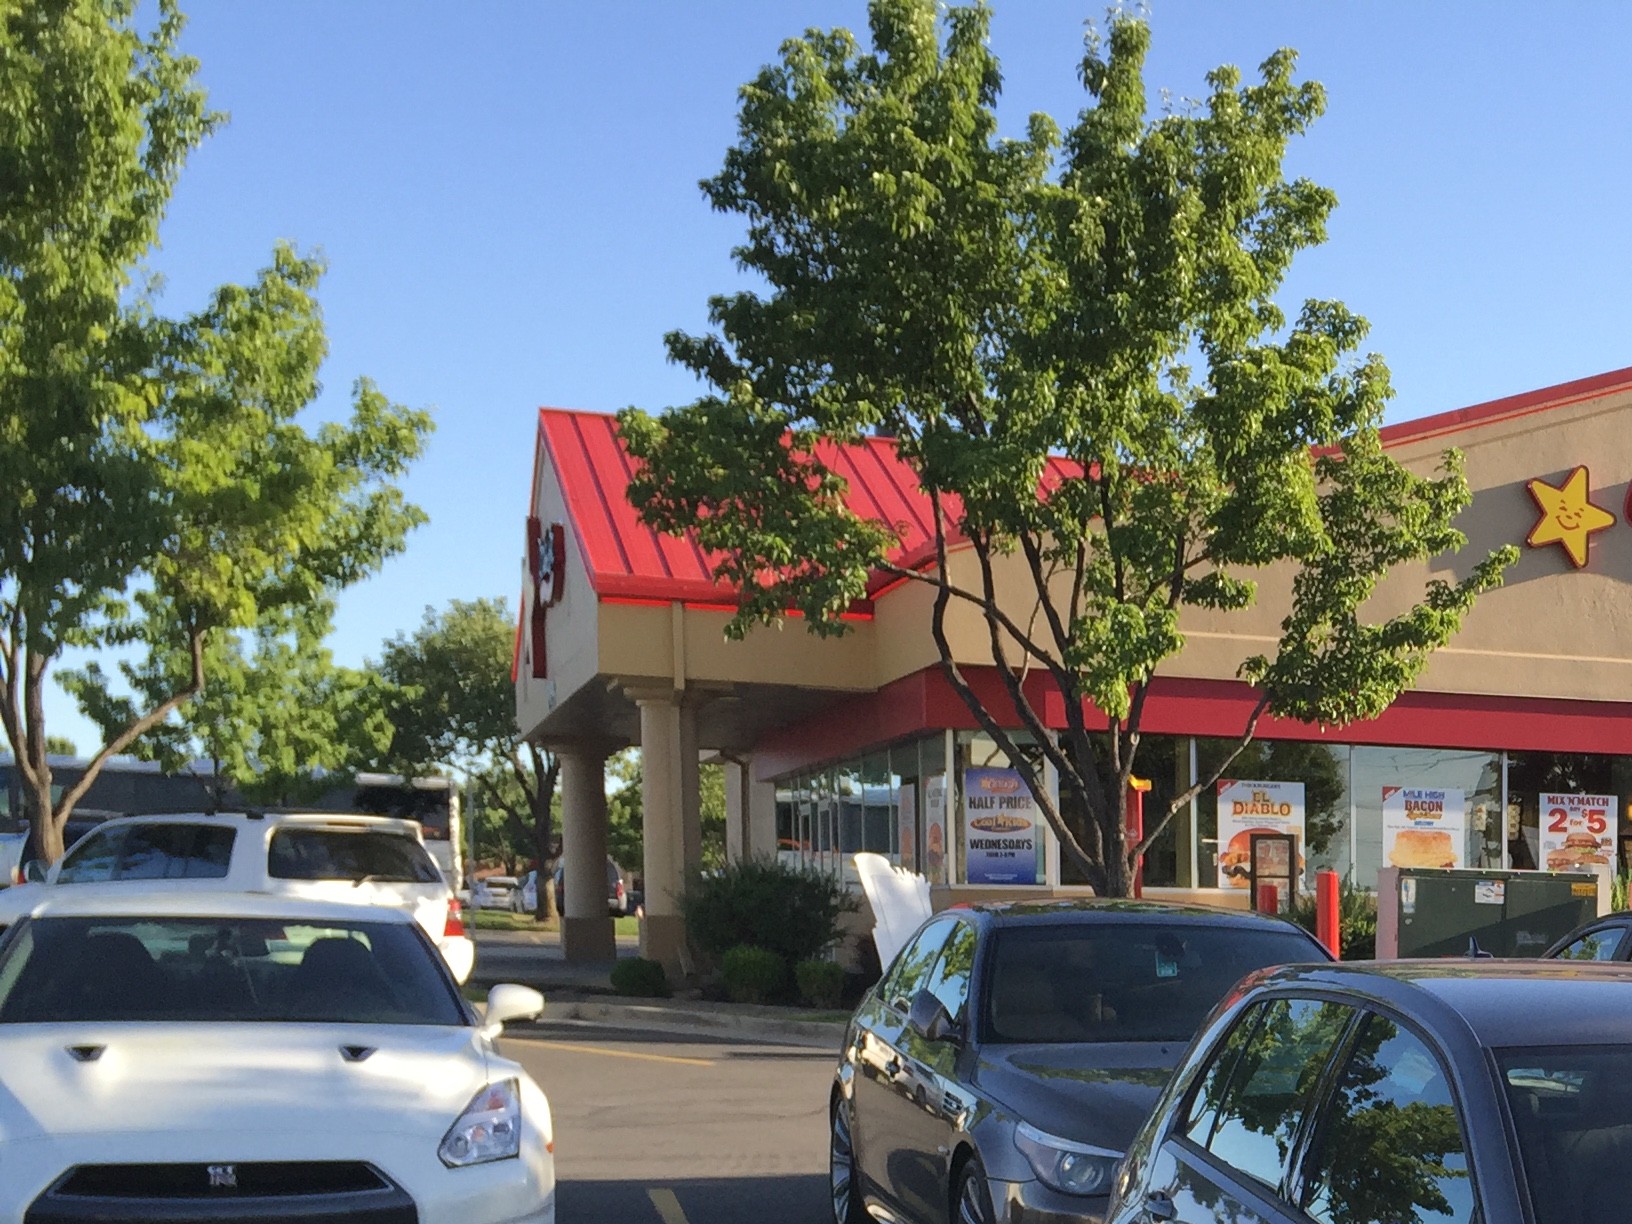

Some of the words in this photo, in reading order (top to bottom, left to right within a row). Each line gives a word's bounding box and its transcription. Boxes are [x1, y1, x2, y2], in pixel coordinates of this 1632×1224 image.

[1252, 792, 1270, 803] EL
[1403, 790, 1422, 799] MILE
[1425, 791, 1445, 799] HIGH
[968, 796, 995, 809] HALF
[999, 796, 1031, 809] PRICE
[1405, 800, 1443, 812] BACON
[1547, 795, 1565, 805] MIX
[1578, 796, 1609, 807] MATCH
[1232, 801, 1291, 816] DIABLO
[1548, 807, 1568, 832] 2
[969, 839, 1033, 850] WEDNESDAYS
